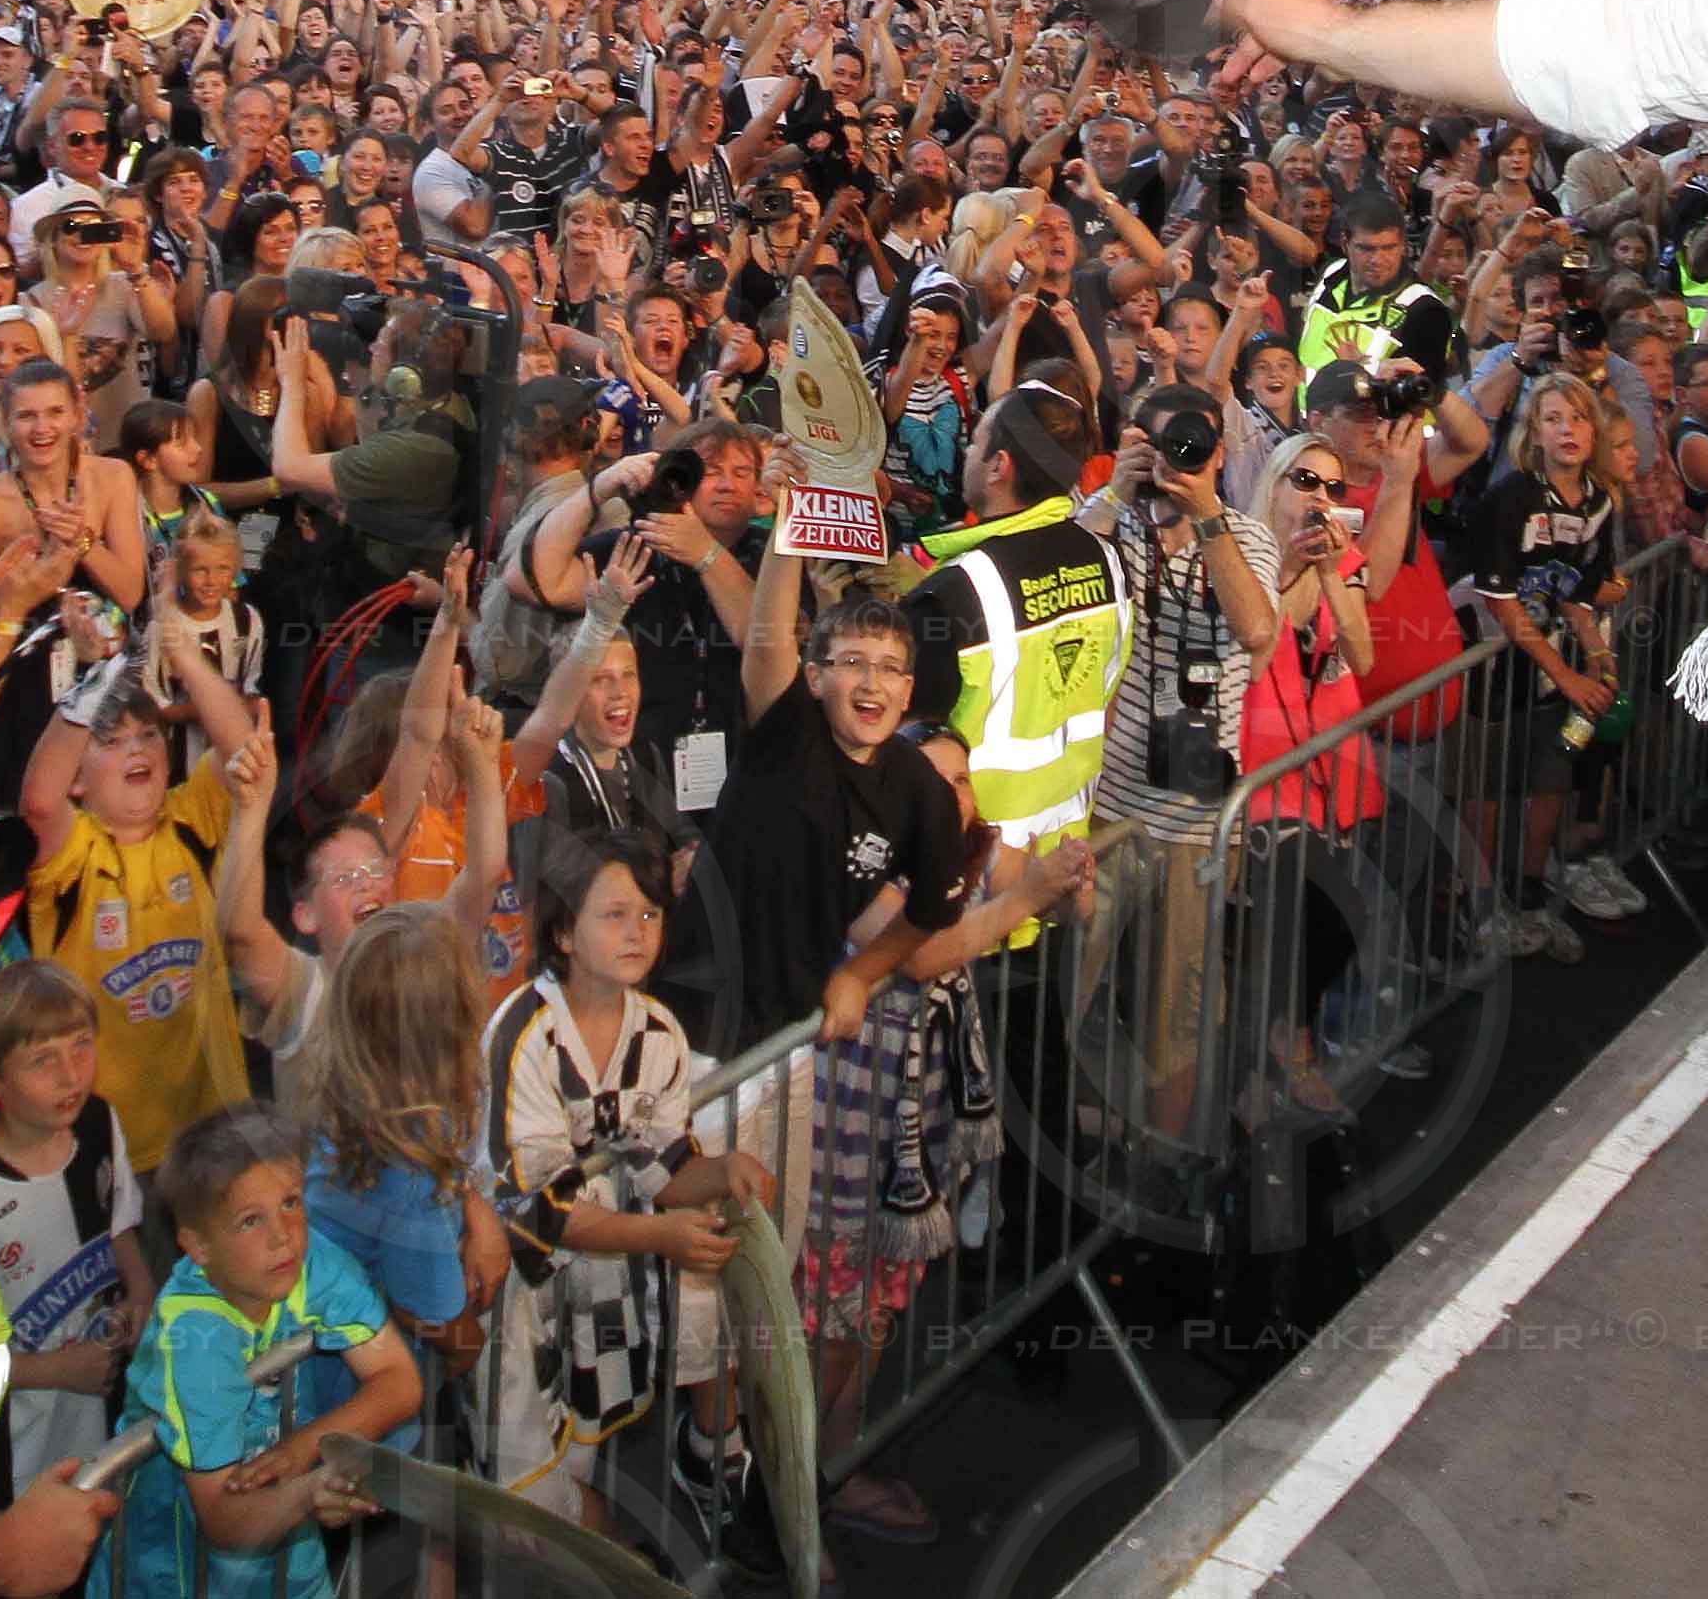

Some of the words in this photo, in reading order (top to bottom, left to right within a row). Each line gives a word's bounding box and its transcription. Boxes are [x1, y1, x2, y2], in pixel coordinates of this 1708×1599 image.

[791, 490, 878, 525] KLEINE
[791, 523, 882, 551] ZEITUNG
[1023, 577, 1108, 621] SECURITY
